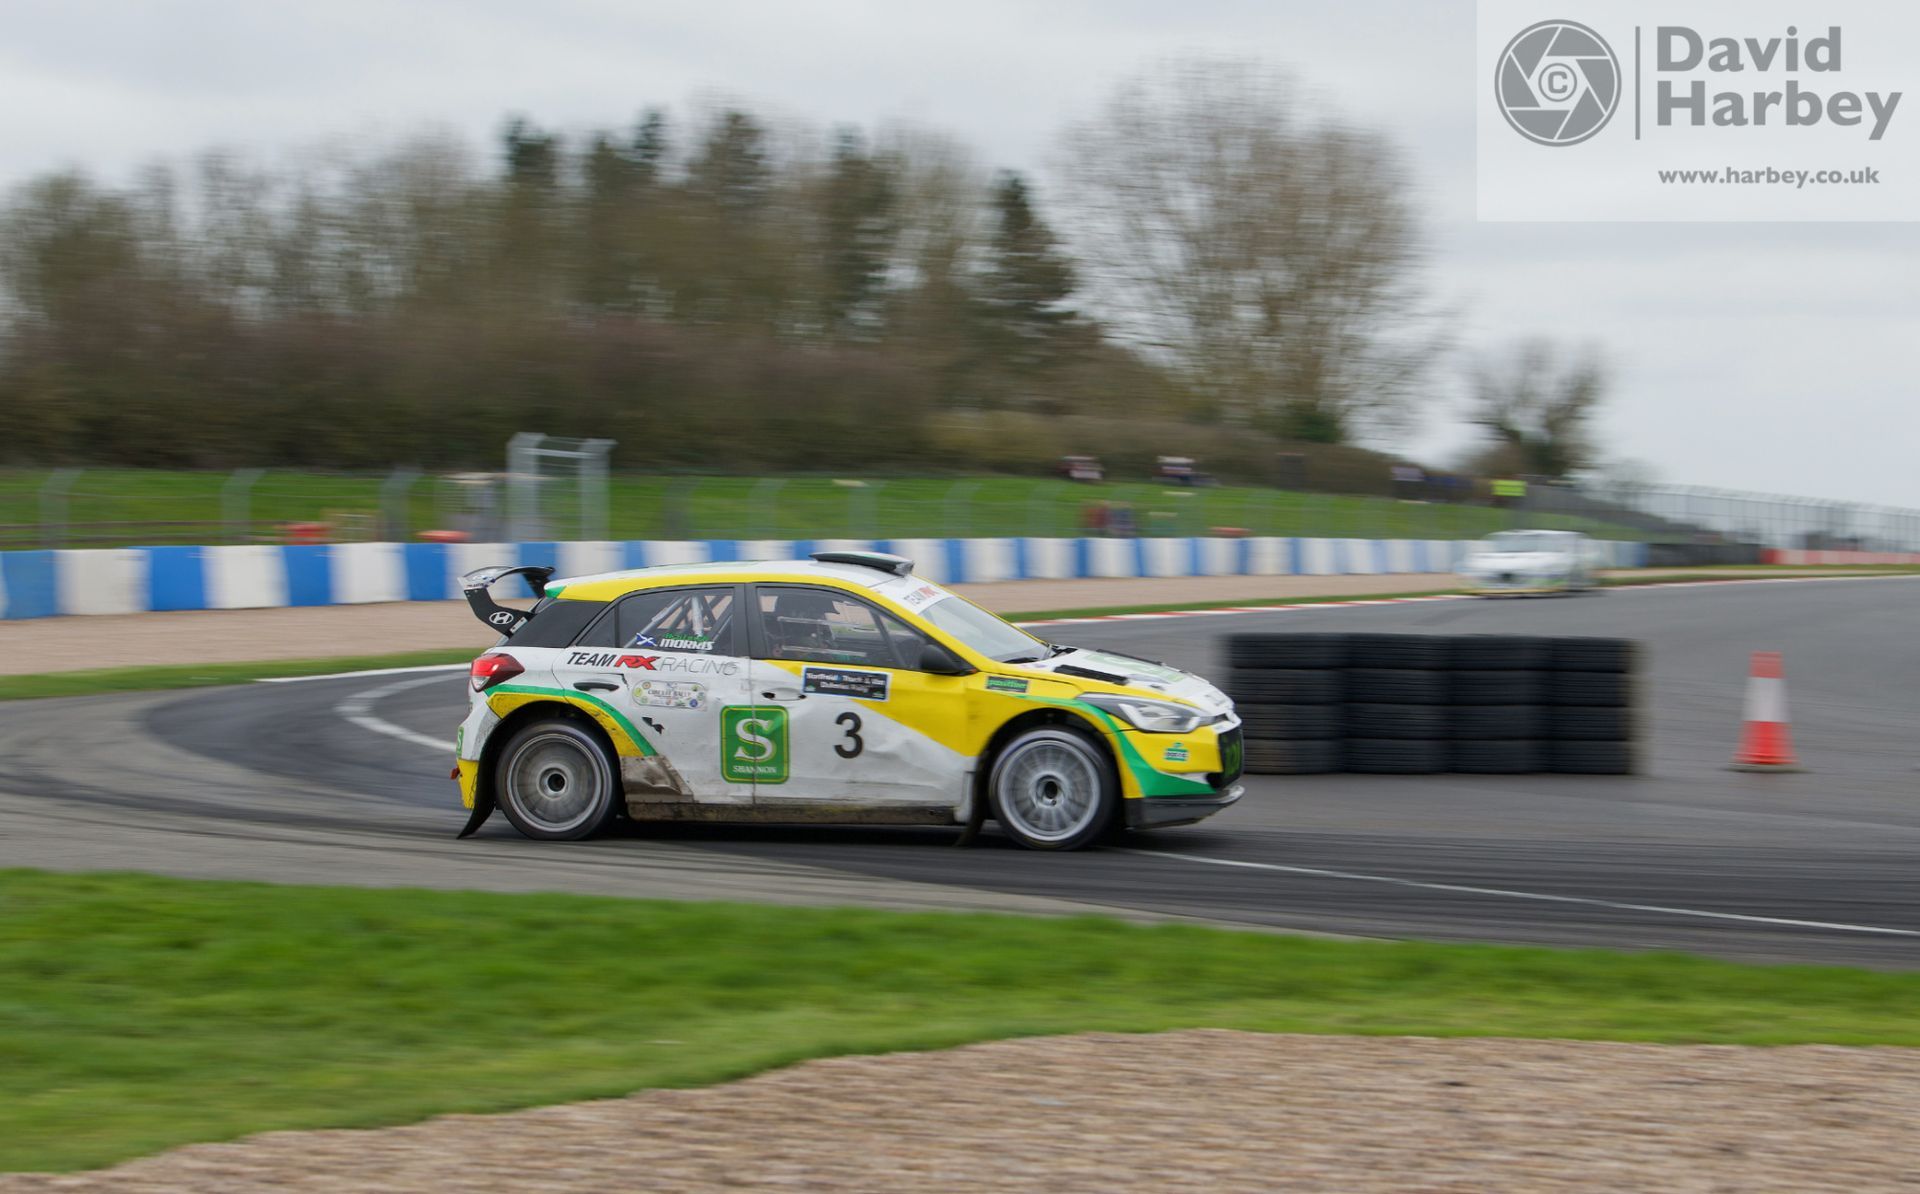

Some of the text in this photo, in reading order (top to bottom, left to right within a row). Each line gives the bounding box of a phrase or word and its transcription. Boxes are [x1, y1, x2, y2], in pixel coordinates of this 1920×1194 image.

[567, 651, 740, 676] TEAM RX RACING
[733, 717, 775, 762] S
[834, 712, 863, 759] 3
